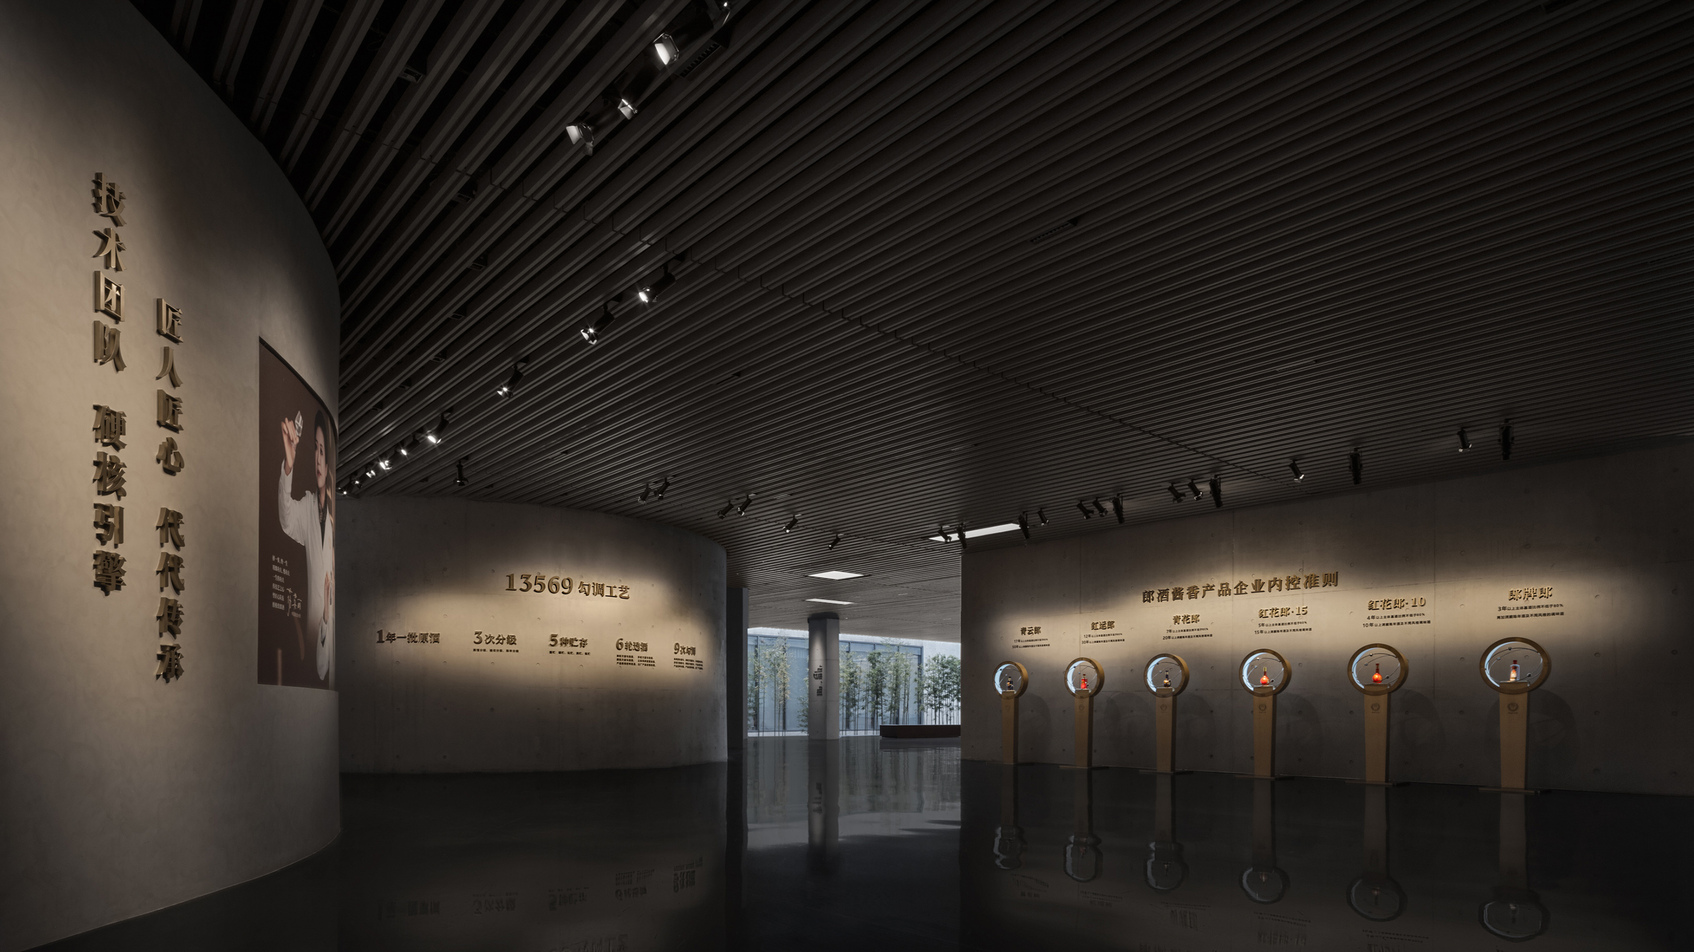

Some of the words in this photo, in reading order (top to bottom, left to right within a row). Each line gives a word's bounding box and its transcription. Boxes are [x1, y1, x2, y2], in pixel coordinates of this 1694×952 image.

[92, 172, 127, 373] 技术团队
[156, 297, 185, 477] 匠人匠心
[93, 404, 127, 597] 硬核引擎
[155, 507, 185, 684] 代代传承
[505, 573, 574, 595] 13569
[578, 580, 630, 600] 勾调工艺
[1142, 571, 1339, 603] 郎酒酱香产品企业内控准则
[1508, 586, 1553, 601] 郎牌郎
[1172, 613, 1201, 625] 青花郎
[376, 629, 441, 644] 1年一批原酒
[473, 630, 517, 646] 3次分级
[549, 633, 588, 648] 5种贮存
[1020, 626, 1042, 636] 青云郎
